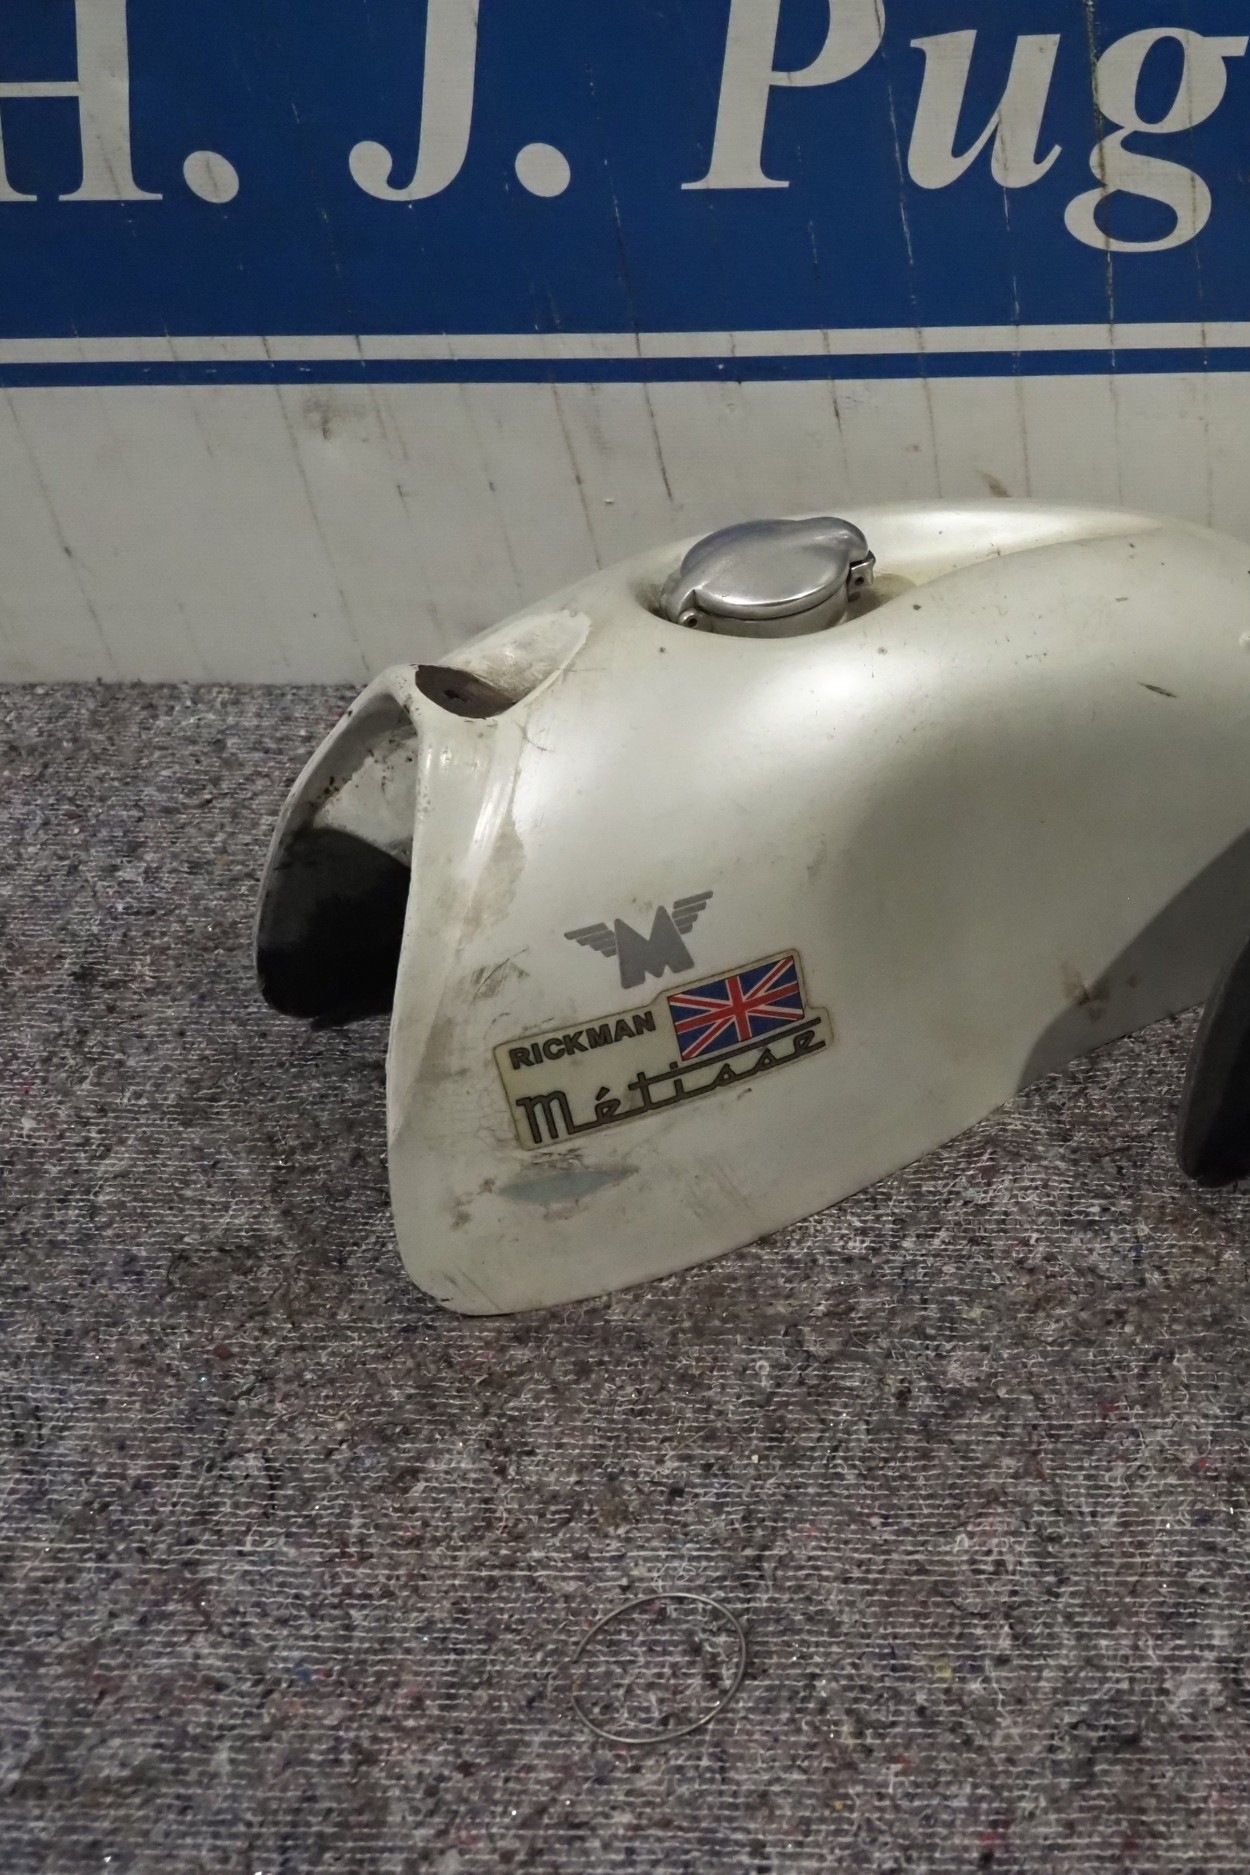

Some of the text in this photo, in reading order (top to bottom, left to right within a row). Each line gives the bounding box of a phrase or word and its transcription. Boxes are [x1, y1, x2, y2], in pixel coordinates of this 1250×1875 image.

[349, 0, 571, 201] J.
[508, 1011, 656, 1070] RICKMAN
[516, 1017, 826, 1144] Métisse
